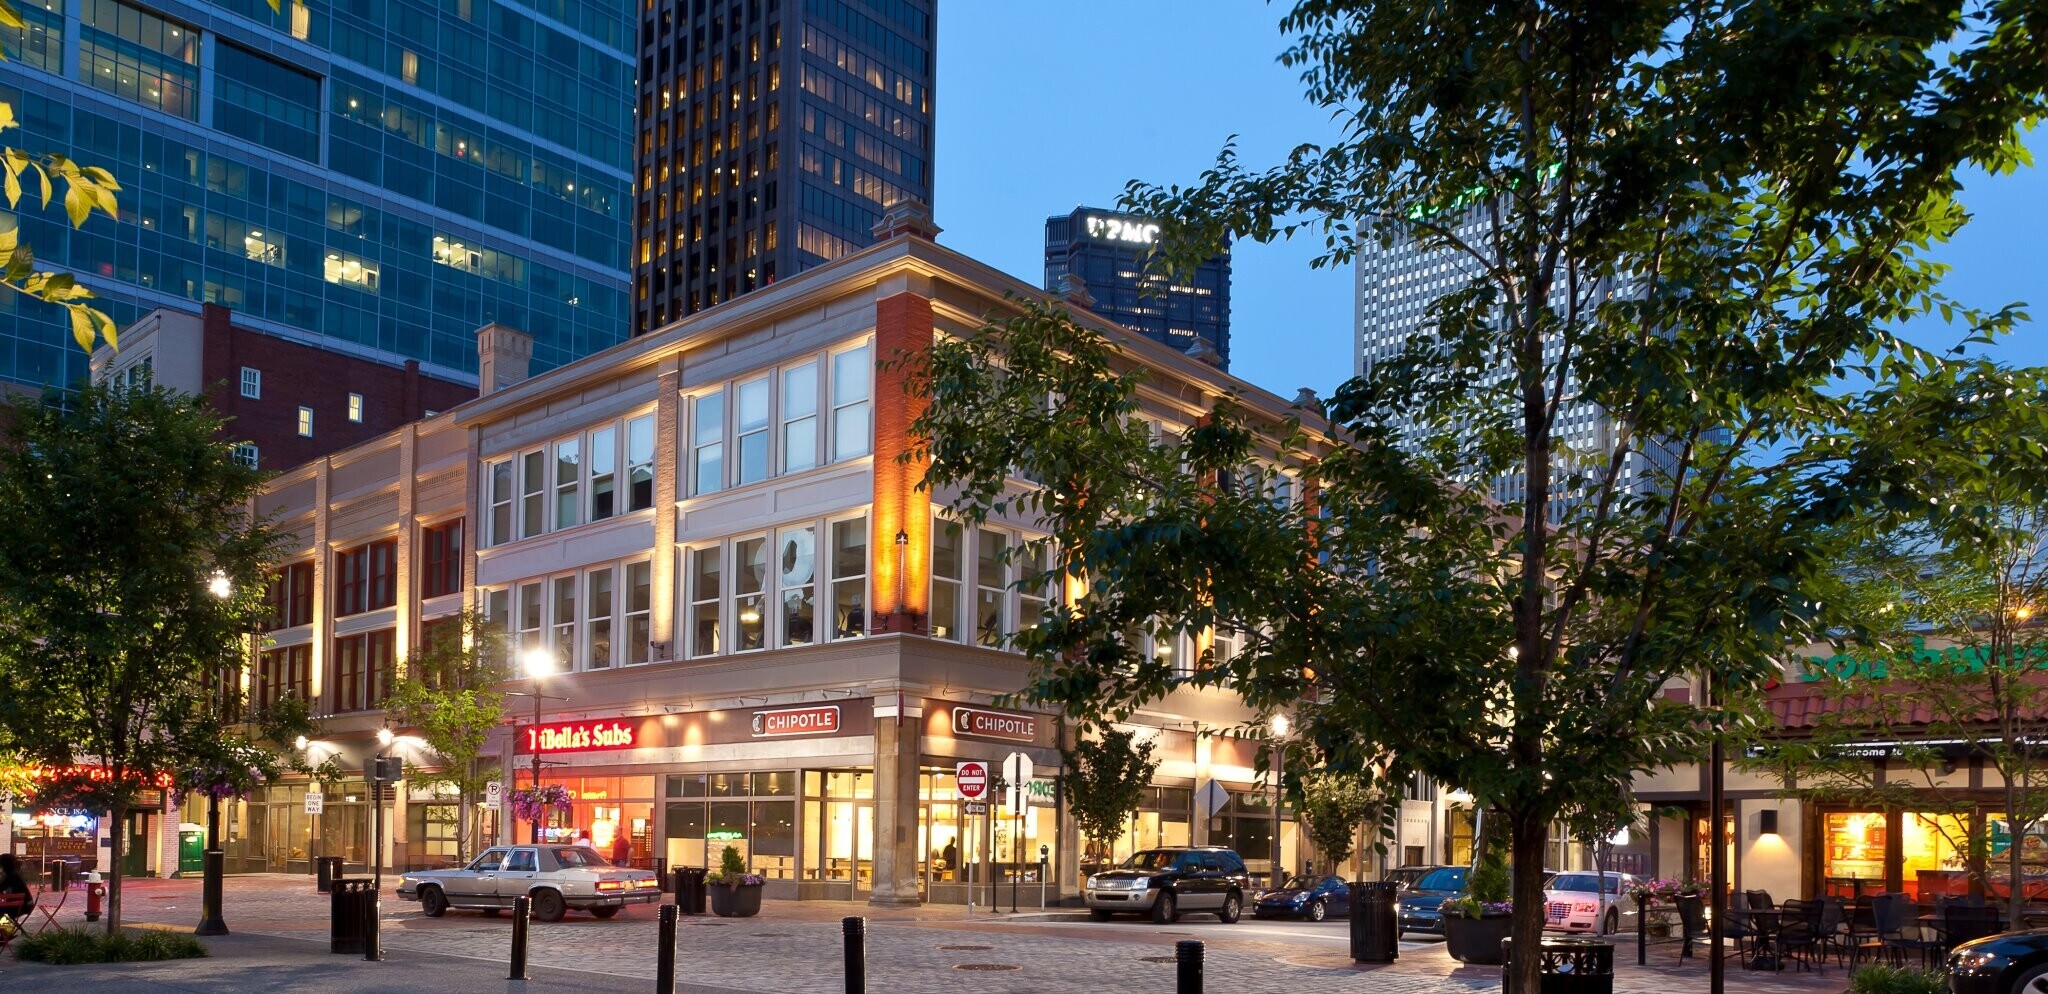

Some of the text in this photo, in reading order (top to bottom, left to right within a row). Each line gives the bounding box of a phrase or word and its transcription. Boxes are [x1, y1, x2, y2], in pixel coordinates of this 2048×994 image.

[767, 712, 832, 730] CHIPOTLE
[976, 716, 1035, 735] CHIPOTLE
[592, 723, 632, 747] Subs
[962, 784, 980, 792] ENTER
